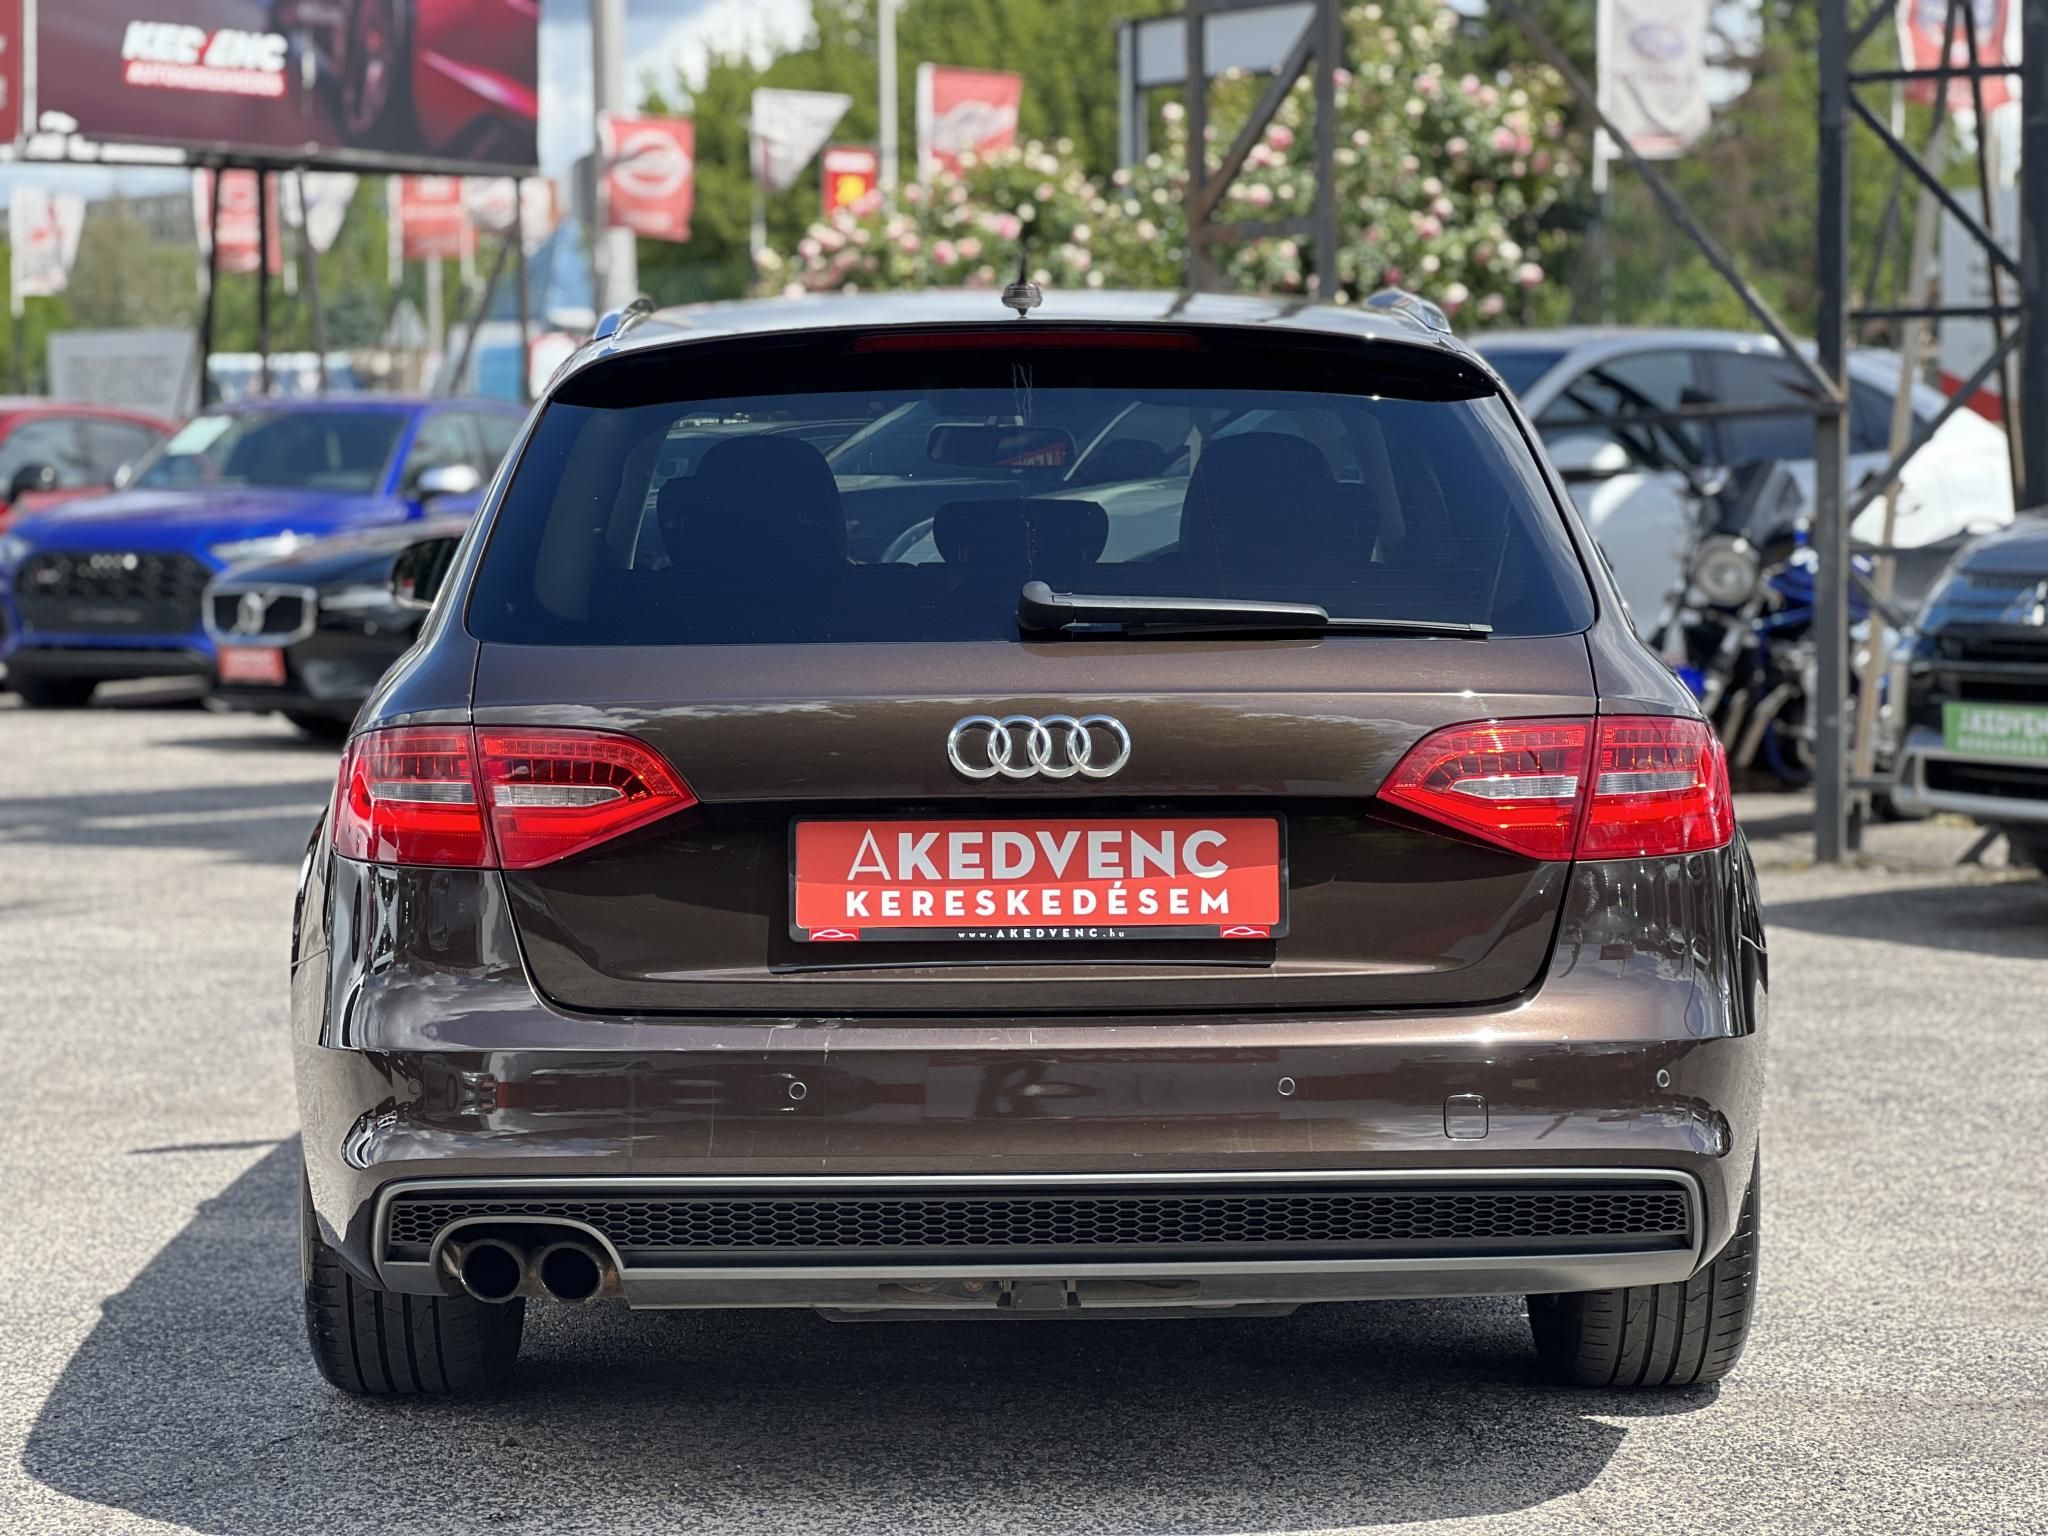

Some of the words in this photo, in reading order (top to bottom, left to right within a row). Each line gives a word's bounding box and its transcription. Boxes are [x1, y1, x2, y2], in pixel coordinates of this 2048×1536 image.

[846, 828, 1229, 881] AKEDVENC
[845, 881, 1231, 920] KERESKEDÉSEM
[957, 927, 1126, 940] www.AKEDVENC.hu
